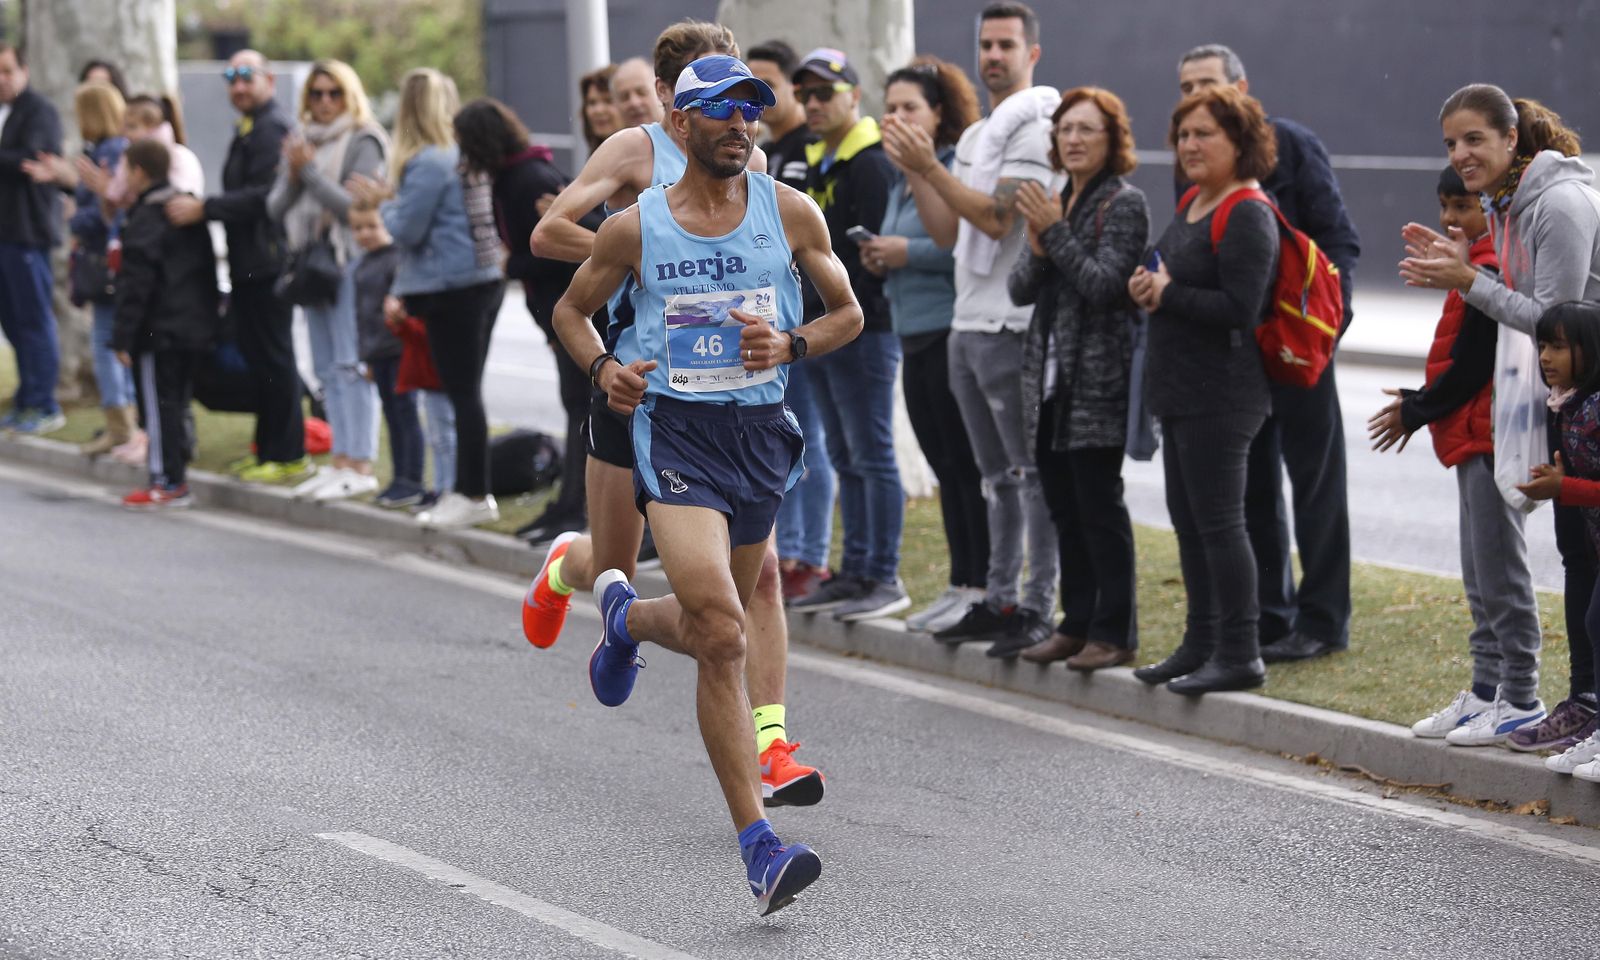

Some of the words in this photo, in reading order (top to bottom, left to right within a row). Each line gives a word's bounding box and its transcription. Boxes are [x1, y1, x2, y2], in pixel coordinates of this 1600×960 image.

[656, 251, 747, 281] nerja
[673, 282, 735, 295] ATLETISMO
[692, 334, 724, 357] 46
